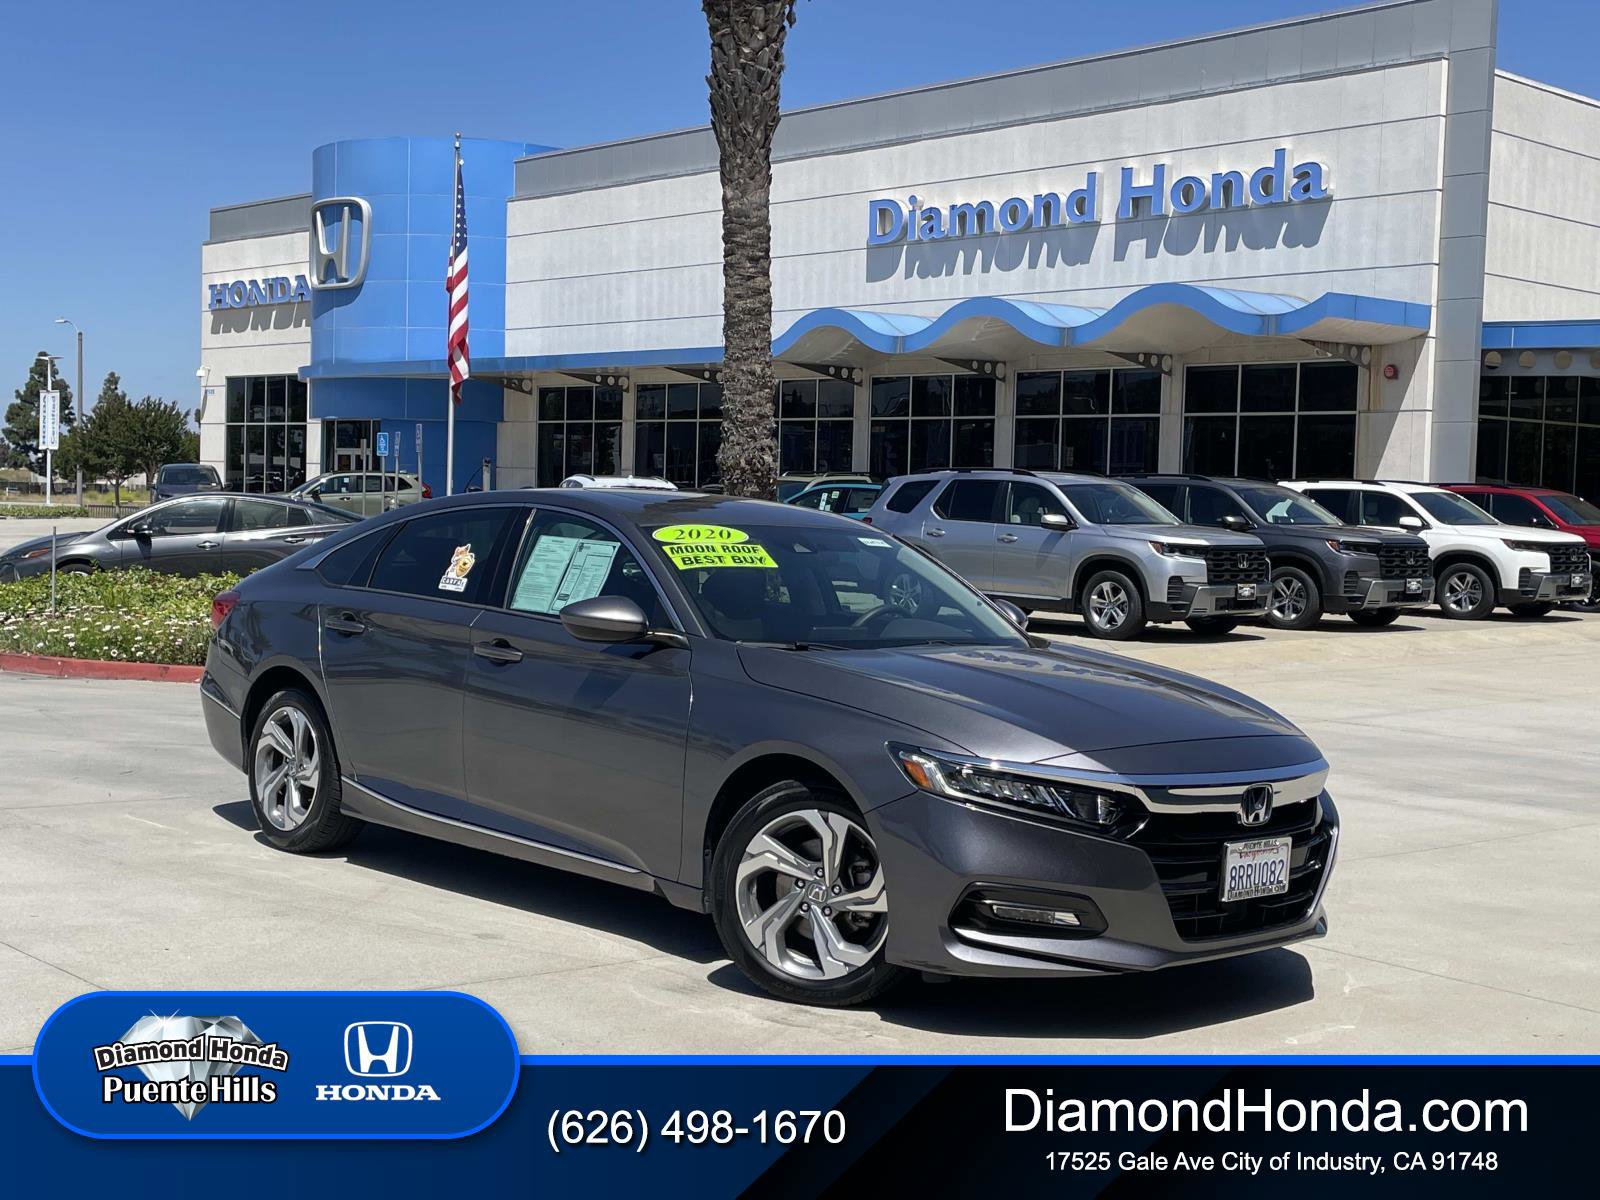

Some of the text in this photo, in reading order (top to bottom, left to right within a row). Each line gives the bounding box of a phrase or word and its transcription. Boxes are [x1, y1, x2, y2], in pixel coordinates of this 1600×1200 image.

[867, 148, 1328, 245] Diamond Honda
[208, 274, 311, 310] HONDA
[674, 529, 731, 540] 2020
[670, 545, 760, 555] MOON ROOF
[681, 555, 766, 565] BEST BUY
[1229, 858, 1284, 891] 8RRU082
